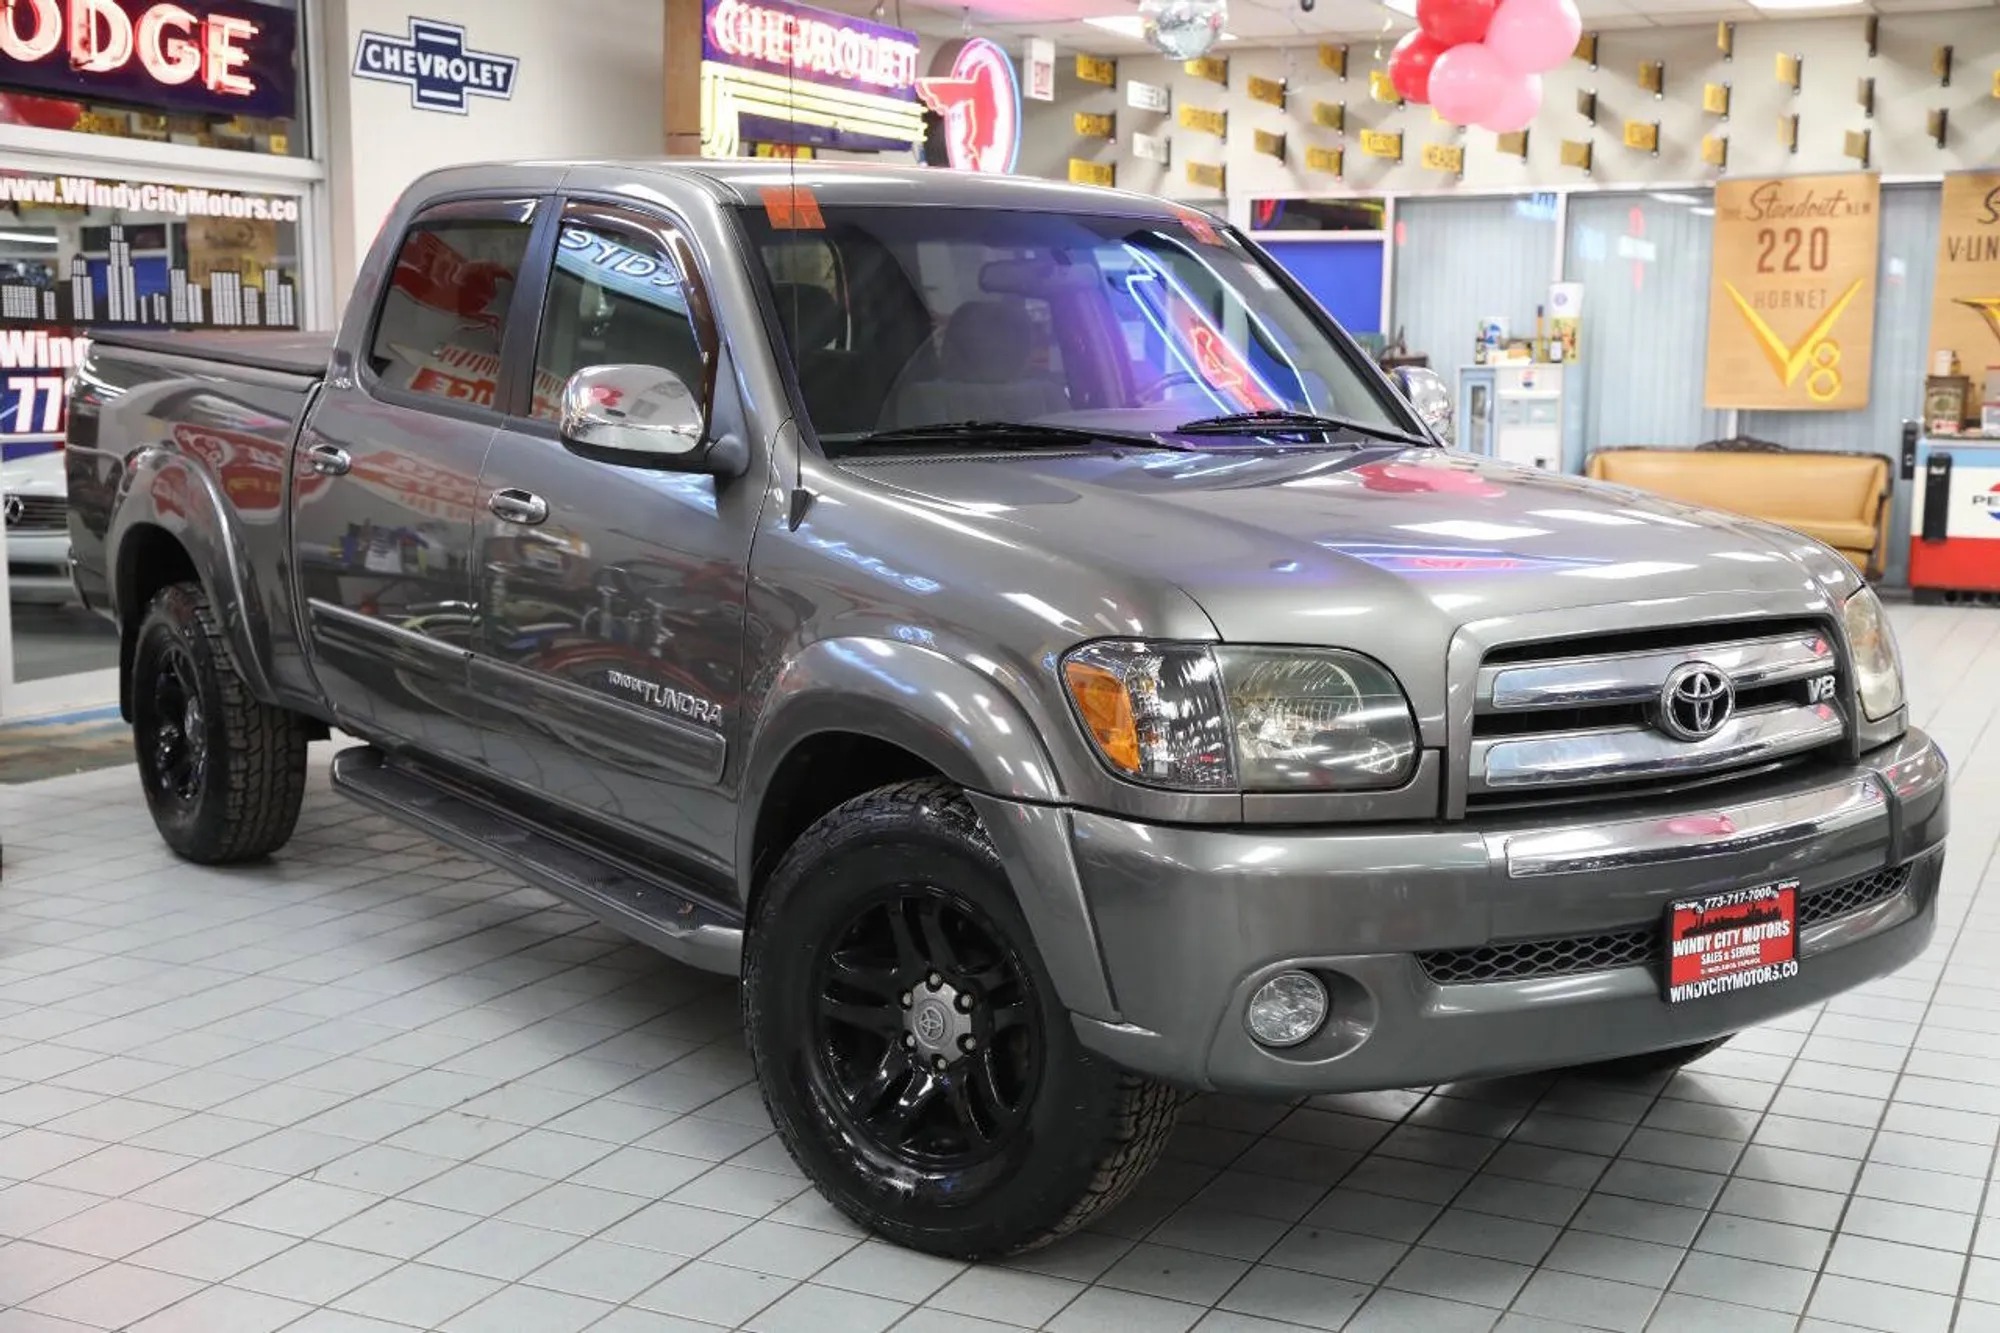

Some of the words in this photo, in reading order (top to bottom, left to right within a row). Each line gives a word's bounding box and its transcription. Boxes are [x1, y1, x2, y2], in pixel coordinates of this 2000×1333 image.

[709, 0, 920, 89] CHEVROLET
[365, 43, 508, 89] CHEVROLET
[1746, 180, 1848, 222] Standout
[1756, 226, 1829, 273] 220
[1754, 290, 1828, 310] HORNET
[644, 682, 723, 728] TUNDRA
[1807, 674, 1836, 703] V8
[1704, 886, 1772, 909] 773-717-7000
[1672, 935, 1712, 957] WINDY
[1714, 928, 1740, 949] CITY
[1742, 920, 1790, 943] MOTORS
[1701, 951, 1723, 965] SALES
[1731, 943, 1761, 959] SERVICE
[1670, 961, 1798, 1003] WINDYCITYMOTORS.CO
